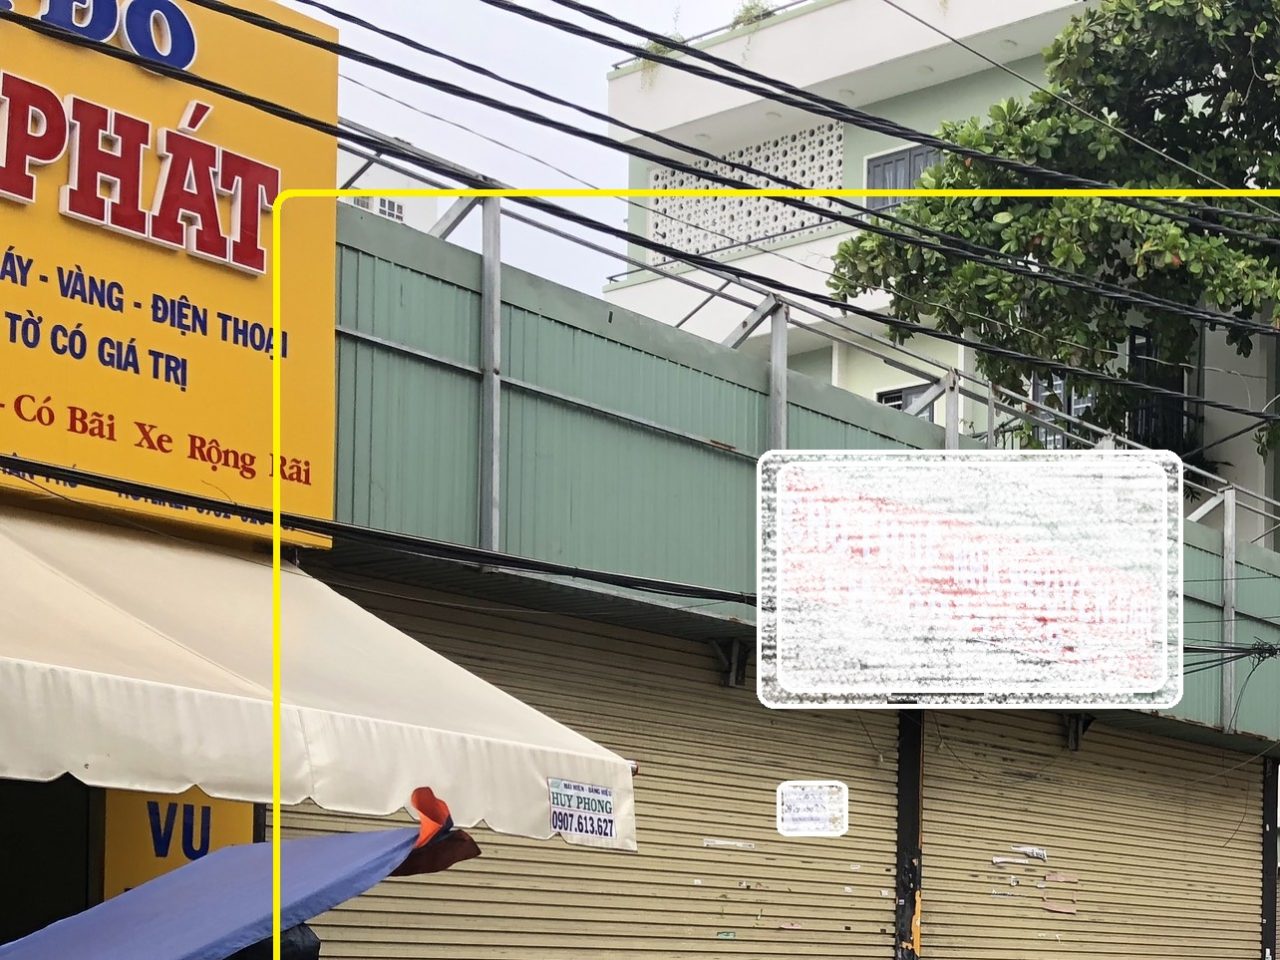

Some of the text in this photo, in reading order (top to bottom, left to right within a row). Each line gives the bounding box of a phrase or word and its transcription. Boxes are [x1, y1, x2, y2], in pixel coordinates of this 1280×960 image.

[0, 71, 281, 275] PHÁT
[56, 265, 124, 313] VÀNG
[151, 293, 208, 336] ĐIỆN
[5, 310, 188, 391] TỜ CÓ GIÁ TRỊ
[13, 393, 312, 486] Có Bãi Xe Rộng Rãi
[551, 791, 612, 815] HUY PHONG
[552, 810, 614, 838] 0907.613.627
